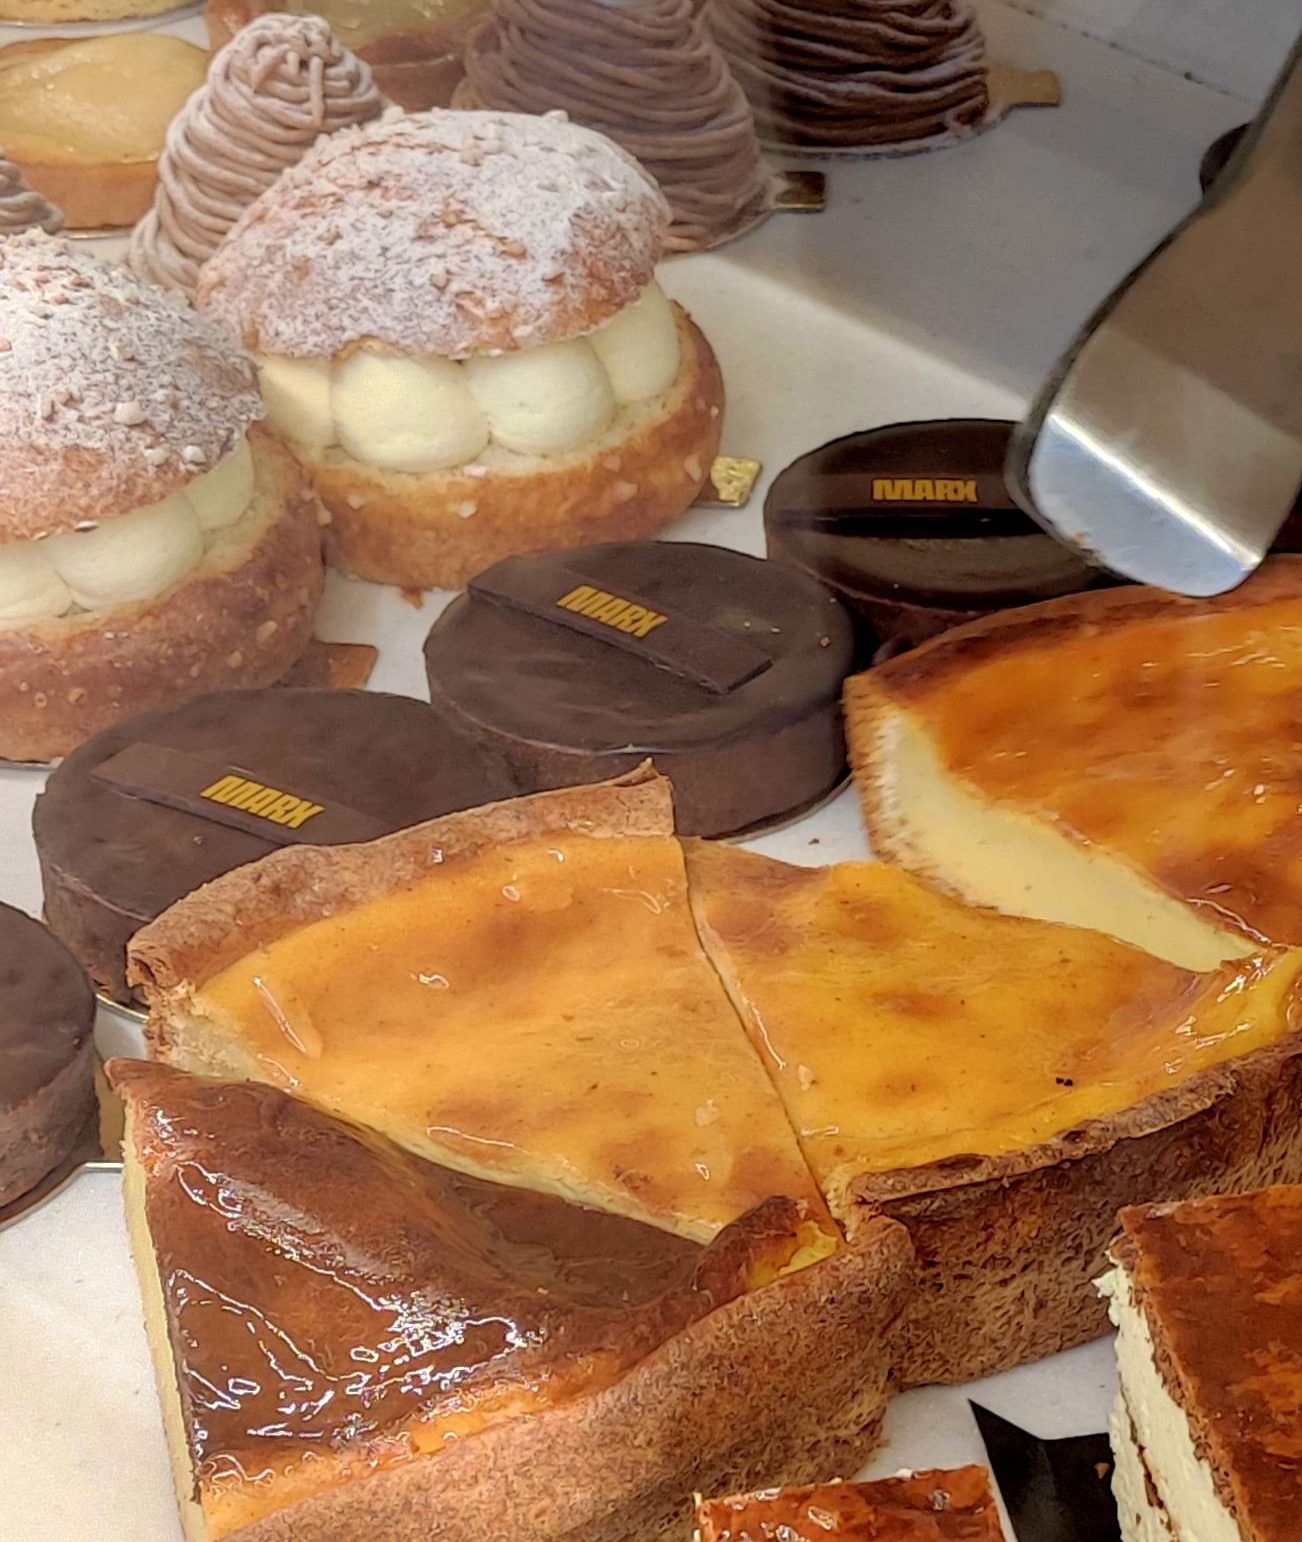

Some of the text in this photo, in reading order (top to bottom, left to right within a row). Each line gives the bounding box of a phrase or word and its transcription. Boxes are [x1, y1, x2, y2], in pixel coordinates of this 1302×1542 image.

[871, 478, 978, 503] MARX
[555, 585, 668, 638] MARX
[200, 774, 325, 829] MARX
